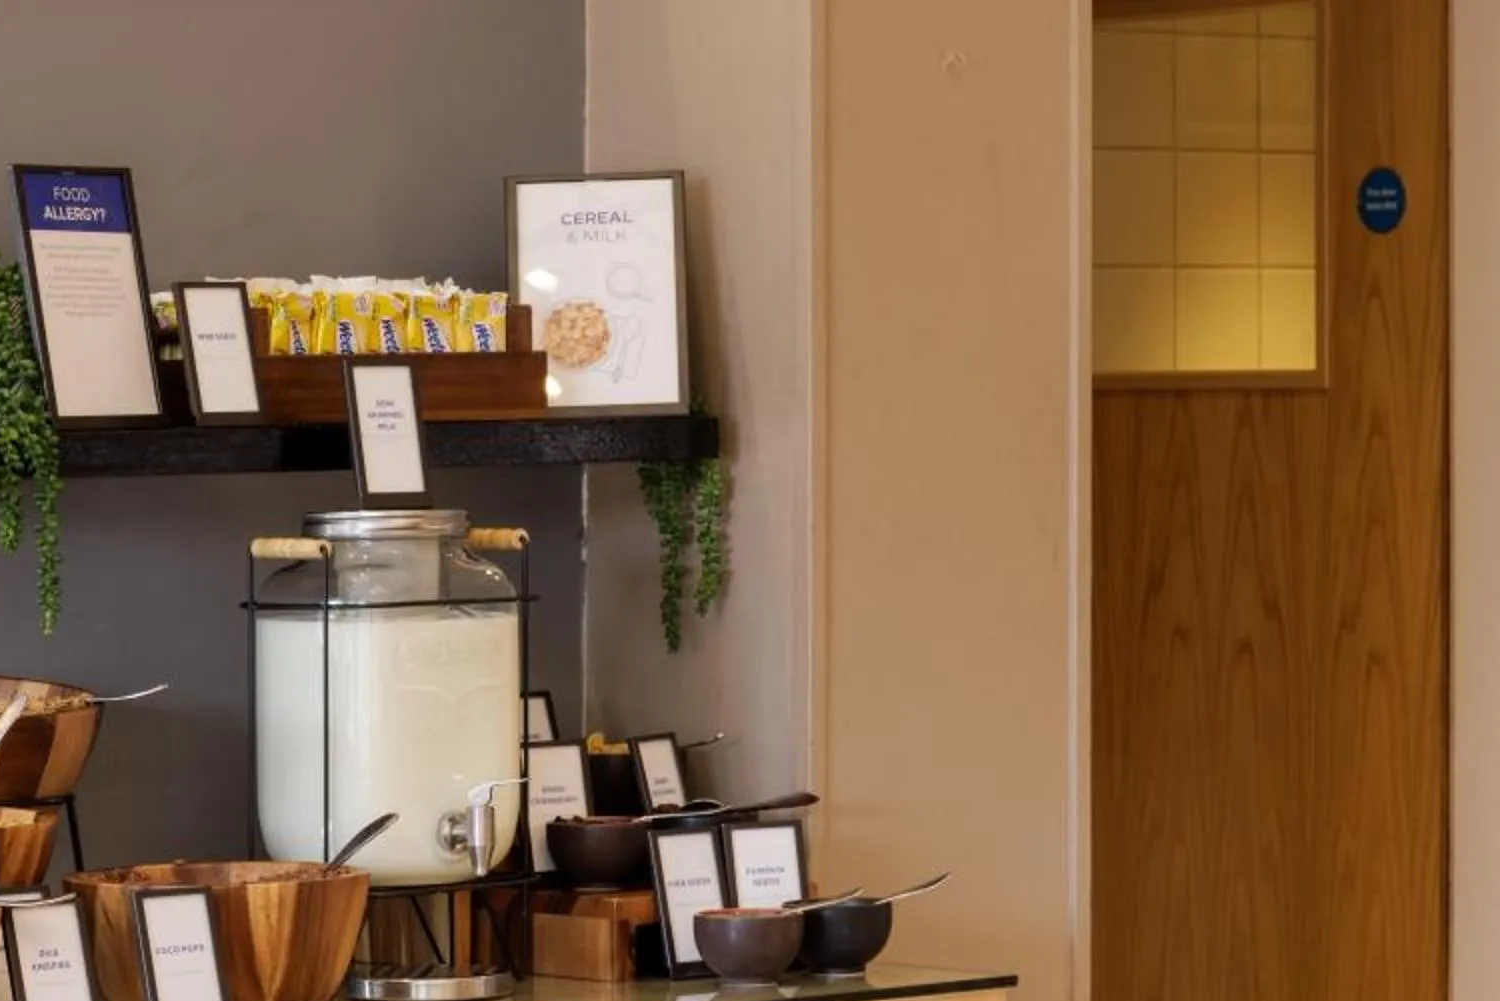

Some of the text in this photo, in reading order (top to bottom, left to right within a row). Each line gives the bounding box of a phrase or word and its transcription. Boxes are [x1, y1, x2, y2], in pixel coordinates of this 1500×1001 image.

[52, 186, 91, 202] FOOD
[43, 204, 108, 223] ALLERGY?
[559, 209, 635, 226] CEREAL
[582, 228, 628, 243] MILK
